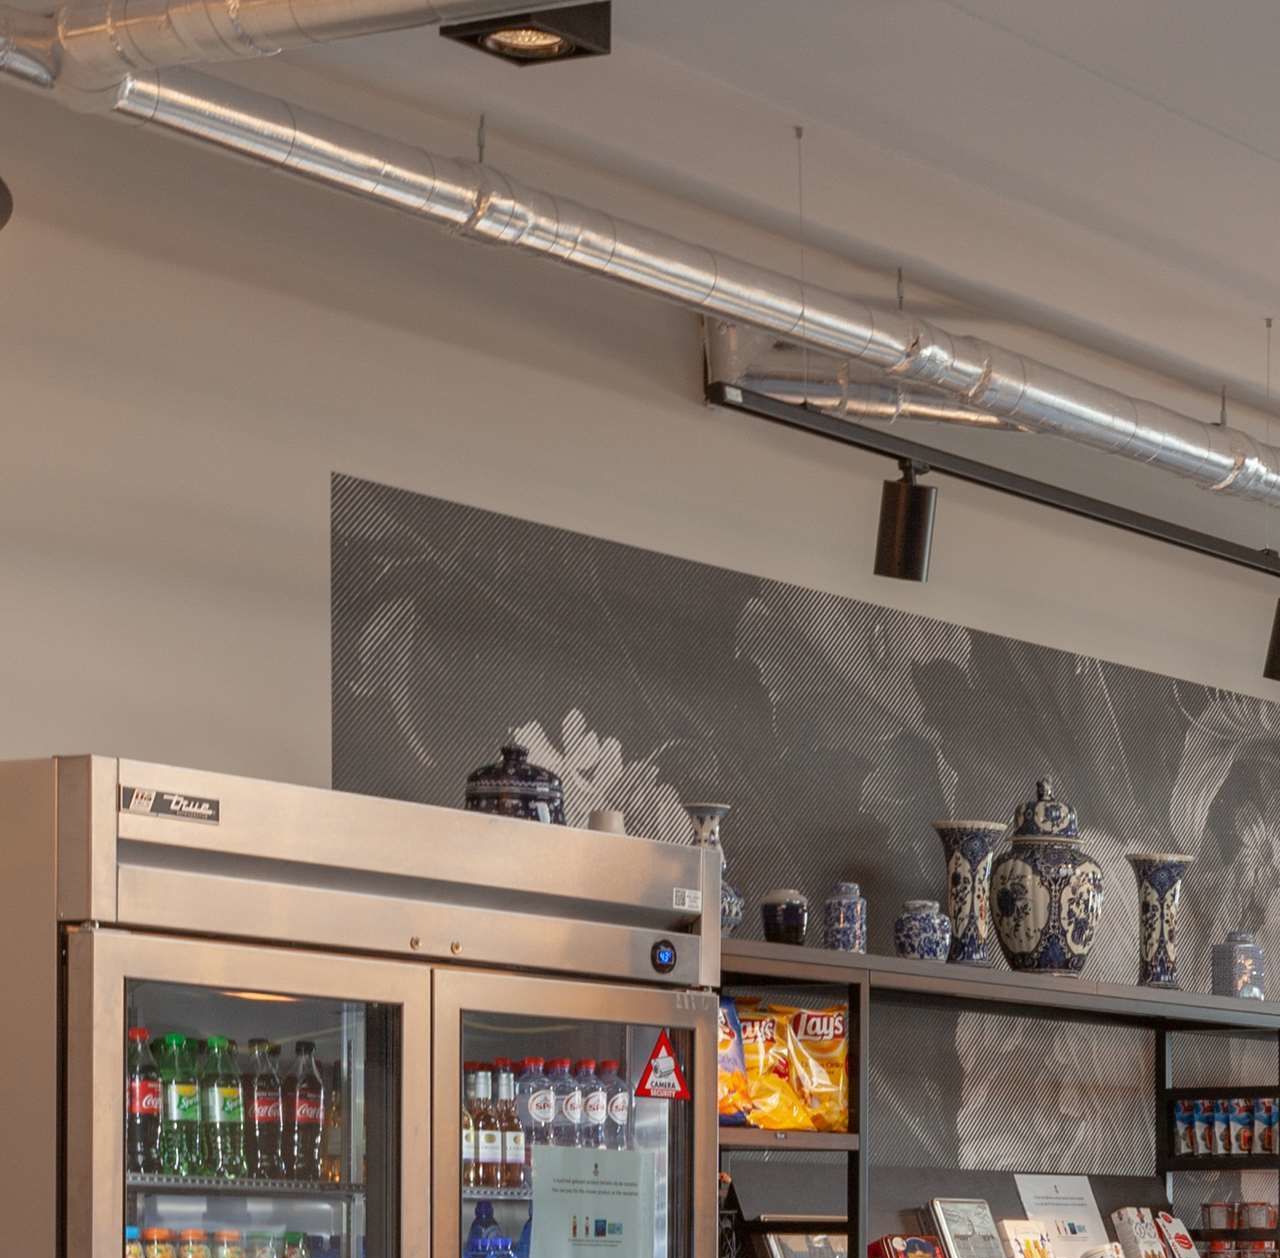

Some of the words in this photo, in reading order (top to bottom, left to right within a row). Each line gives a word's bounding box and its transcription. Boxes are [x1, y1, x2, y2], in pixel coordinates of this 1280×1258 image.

[741, 1018, 775, 1042] ay's
[797, 1011, 844, 1041] Lay's
[650, 1081, 676, 1089] CAMERA
[650, 1089, 676, 1098] SECURITY
